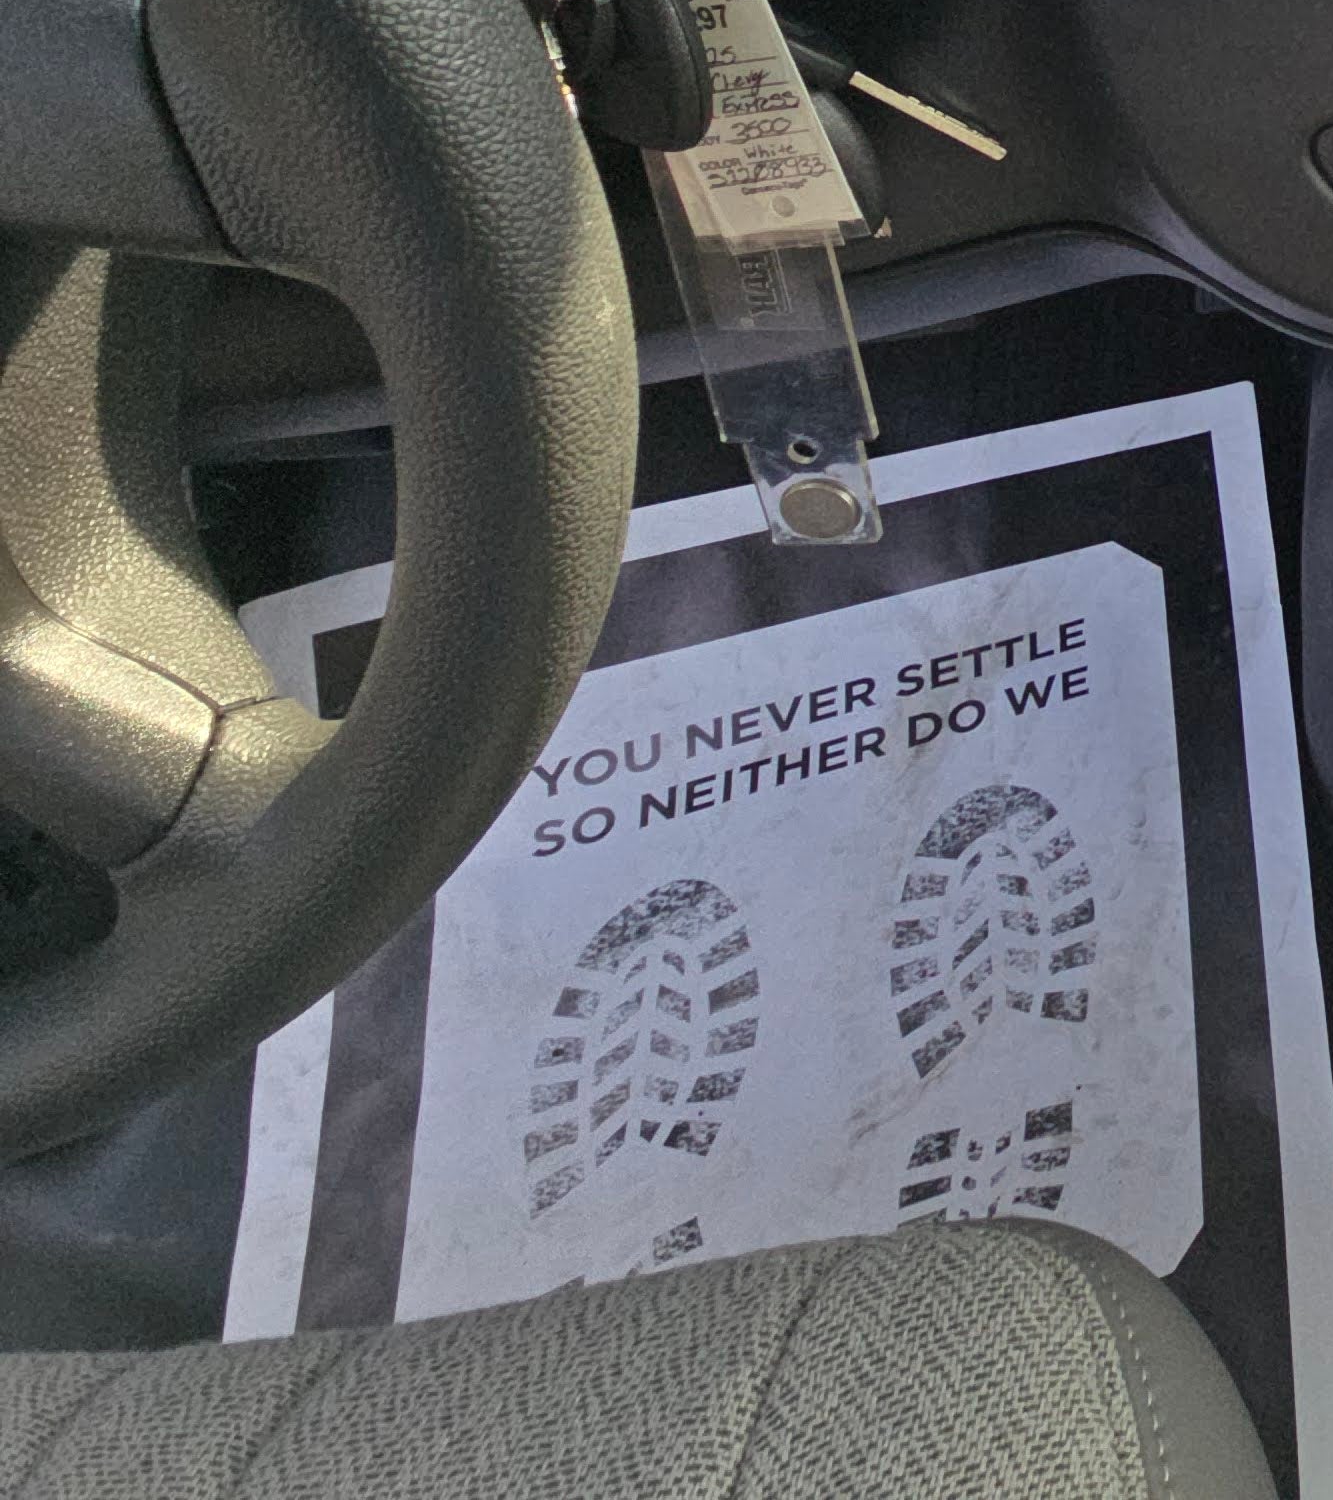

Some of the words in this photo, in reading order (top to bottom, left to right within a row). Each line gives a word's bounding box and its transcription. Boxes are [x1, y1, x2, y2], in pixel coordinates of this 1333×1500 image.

[696, 3, 728, 32] 97
[730, 117, 792, 145] 3500
[531, 732, 661, 798] YOU
[686, 676, 876, 760] NEVER
[896, 617, 1087, 697] SETTLE
[531, 806, 616, 858] SO
[639, 726, 887, 829] NEITHER
[908, 699, 986, 749] DO
[1004, 665, 1090, 716] WE
